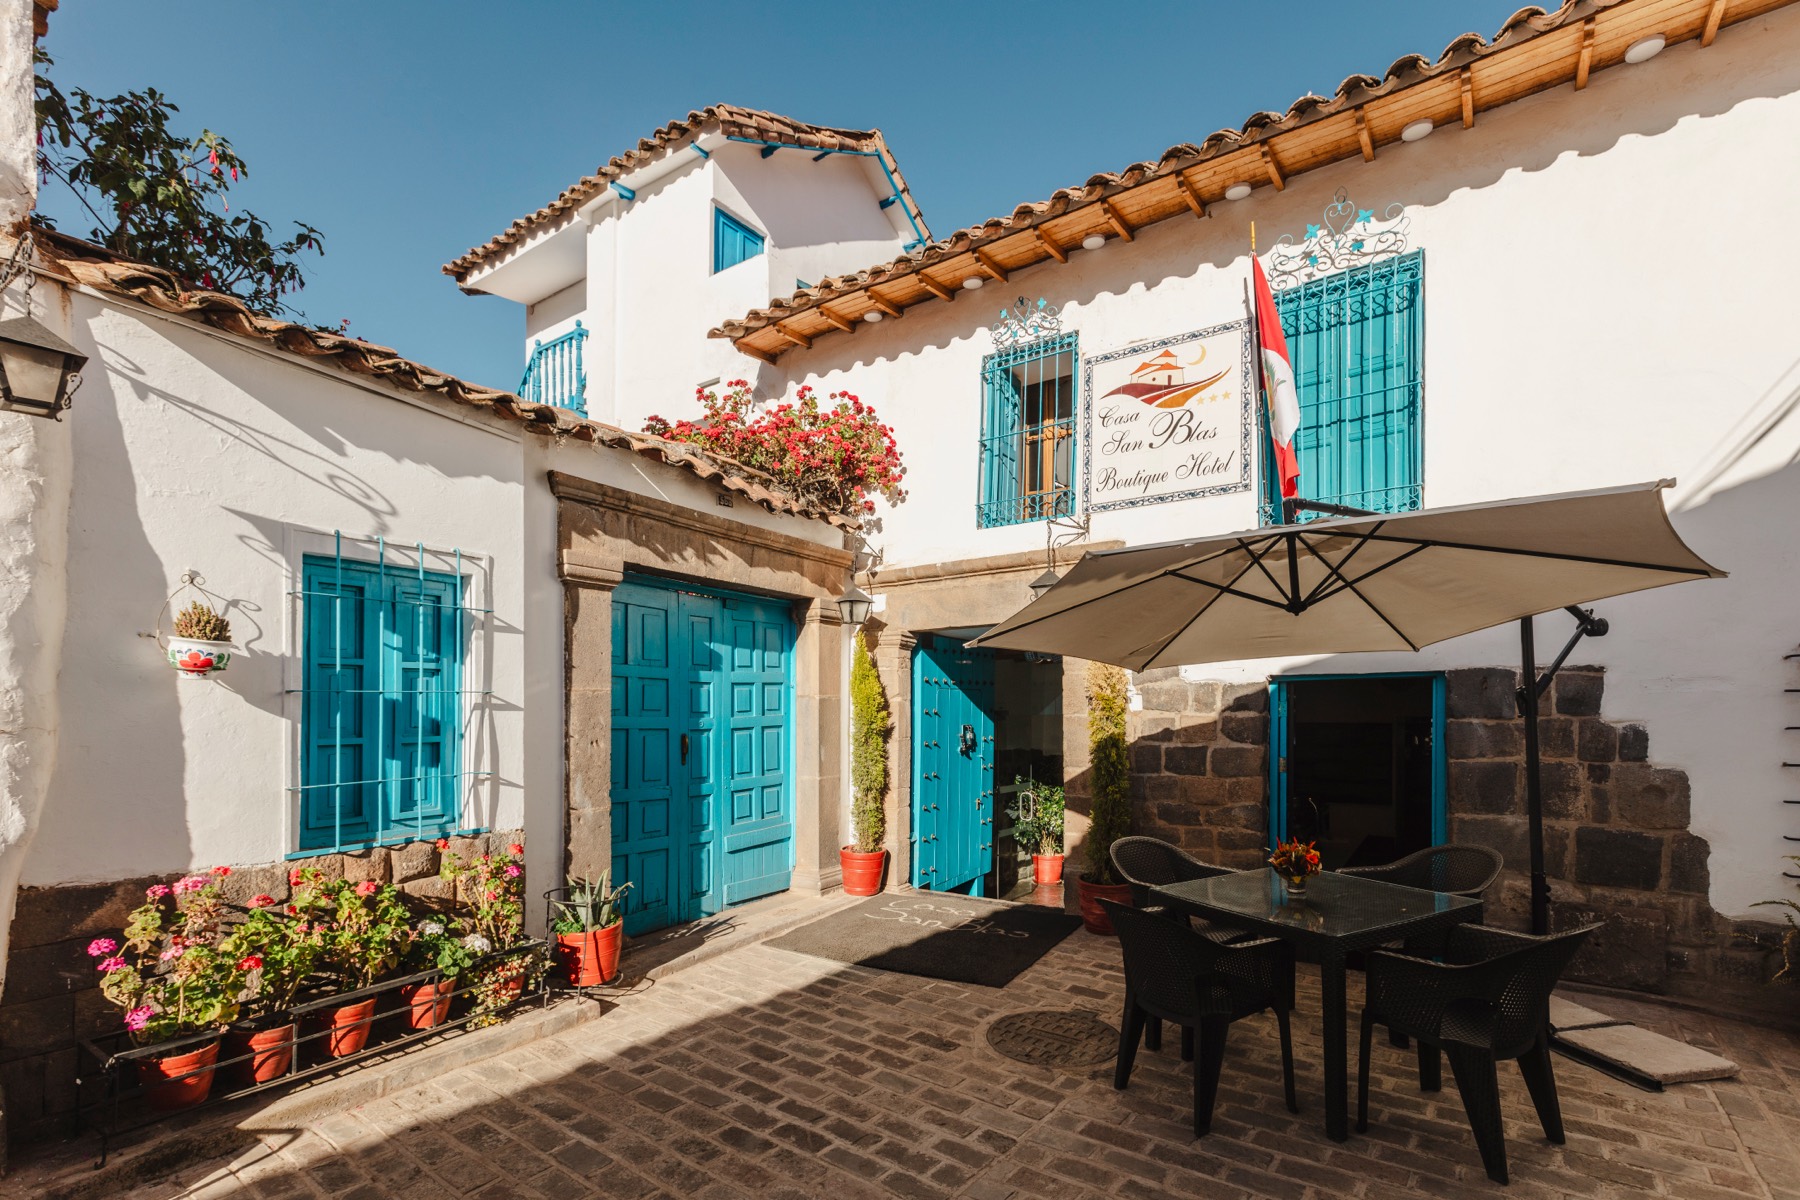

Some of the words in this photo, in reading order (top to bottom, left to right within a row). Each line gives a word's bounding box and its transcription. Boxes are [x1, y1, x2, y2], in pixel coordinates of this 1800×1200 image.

[1098, 404, 1140, 428] Casa
[1101, 429, 1144, 456] San
[1148, 408, 1218, 449] Blas
[1096, 466, 1169, 494] Boutique
[1175, 450, 1235, 480] Hotel
[864, 907, 947, 929] San
[888, 899, 976, 917] Casa
